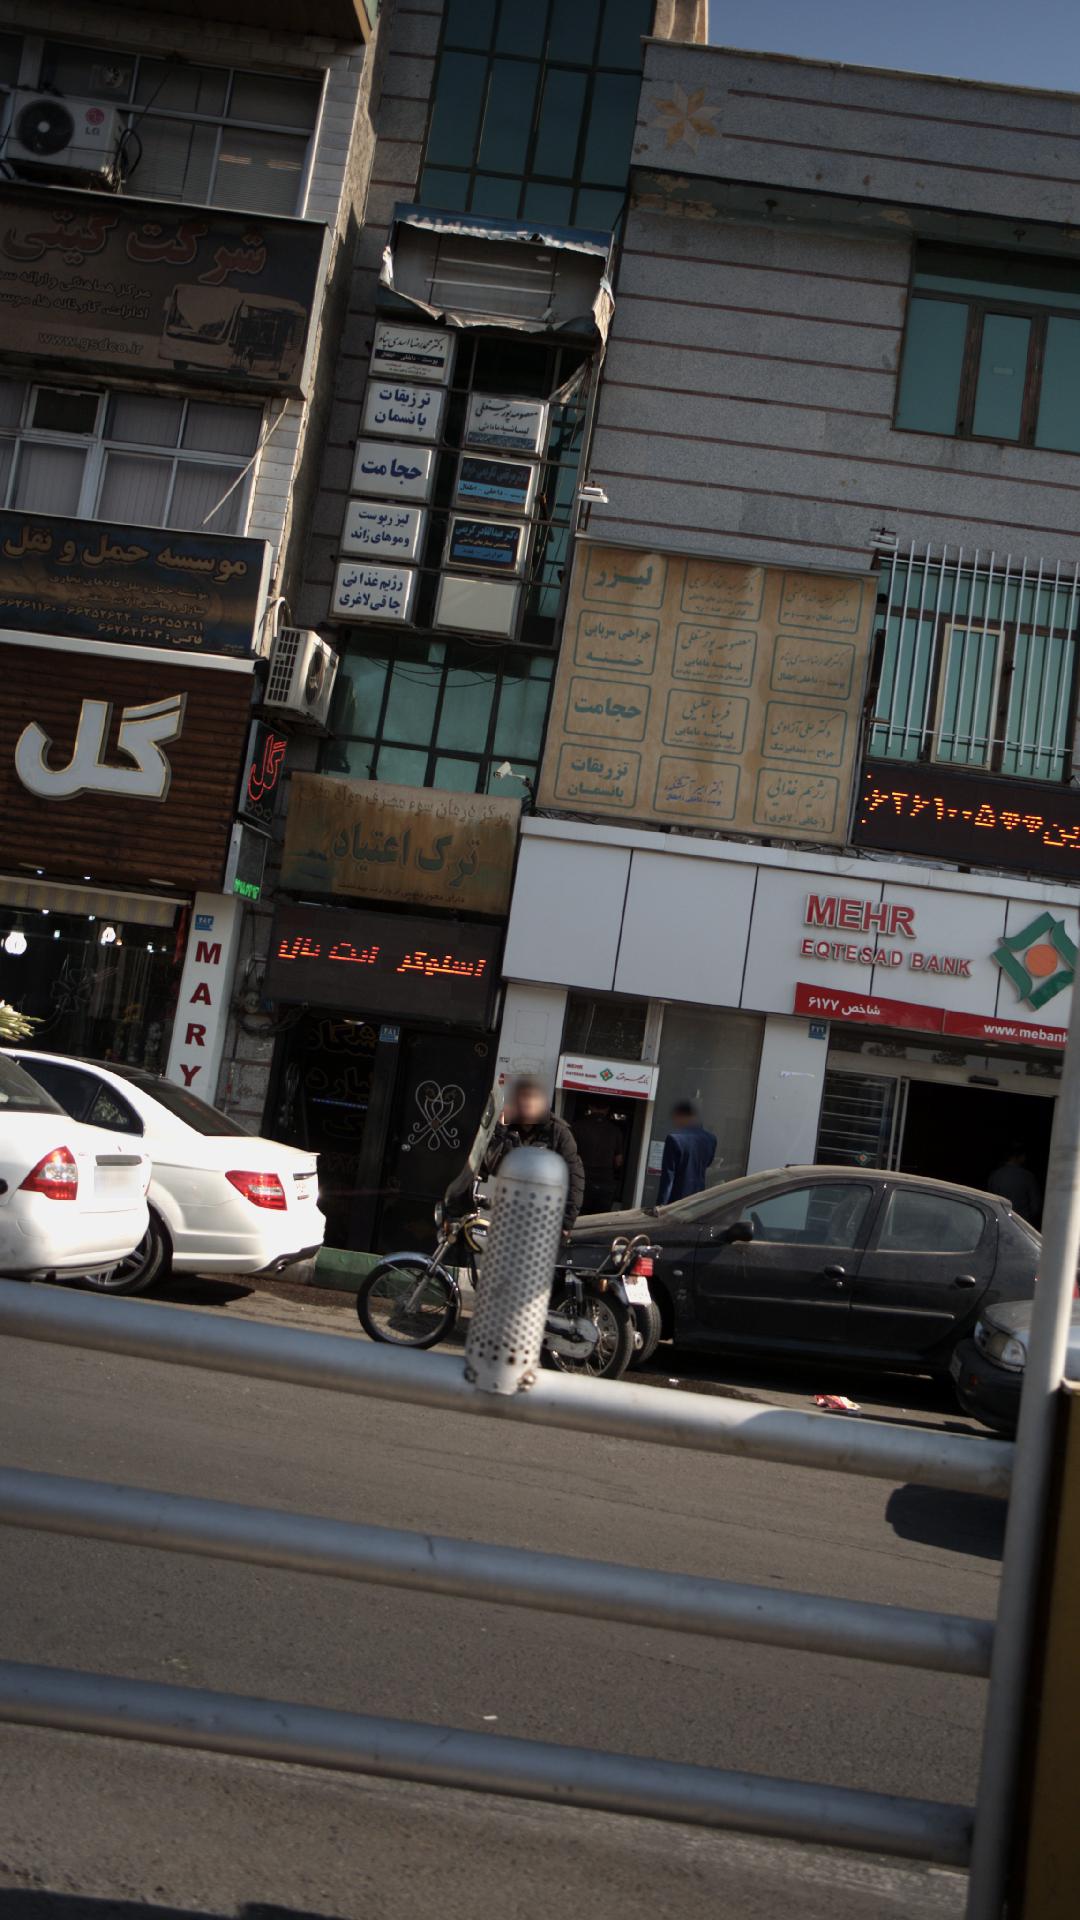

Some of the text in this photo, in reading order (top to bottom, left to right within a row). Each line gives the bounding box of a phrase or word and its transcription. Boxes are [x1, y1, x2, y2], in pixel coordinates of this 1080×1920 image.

[85, 127, 100, 136] LG
[126, 219, 267, 286] شرکت
[38, 332, 144, 354] www.gsdco.ir
[379, 388, 431, 408] تزریقات
[374, 409, 427, 432] پانسمان
[361, 458, 422, 484] حجامت
[387, 513, 410, 527] لیزر
[3, 526, 248, 583] موسسه حمل و نقل
[379, 575, 403, 592] رژیم
[339, 592, 371, 608] لاغری
[574, 697, 642, 723] حجامت
[15, 691, 188, 803] گل
[248, 733, 288, 802] گل
[571, 757, 630, 781] تزریقات
[331, 820, 481, 889] ترک اعتیاد
[804, 893, 916, 939] MEHR
[800, 938, 974, 977] EQTESAD BANK
[179, 941, 222, 1087] MARY
[807, 996, 881, 1017] شاخص ۶۱۷۷
